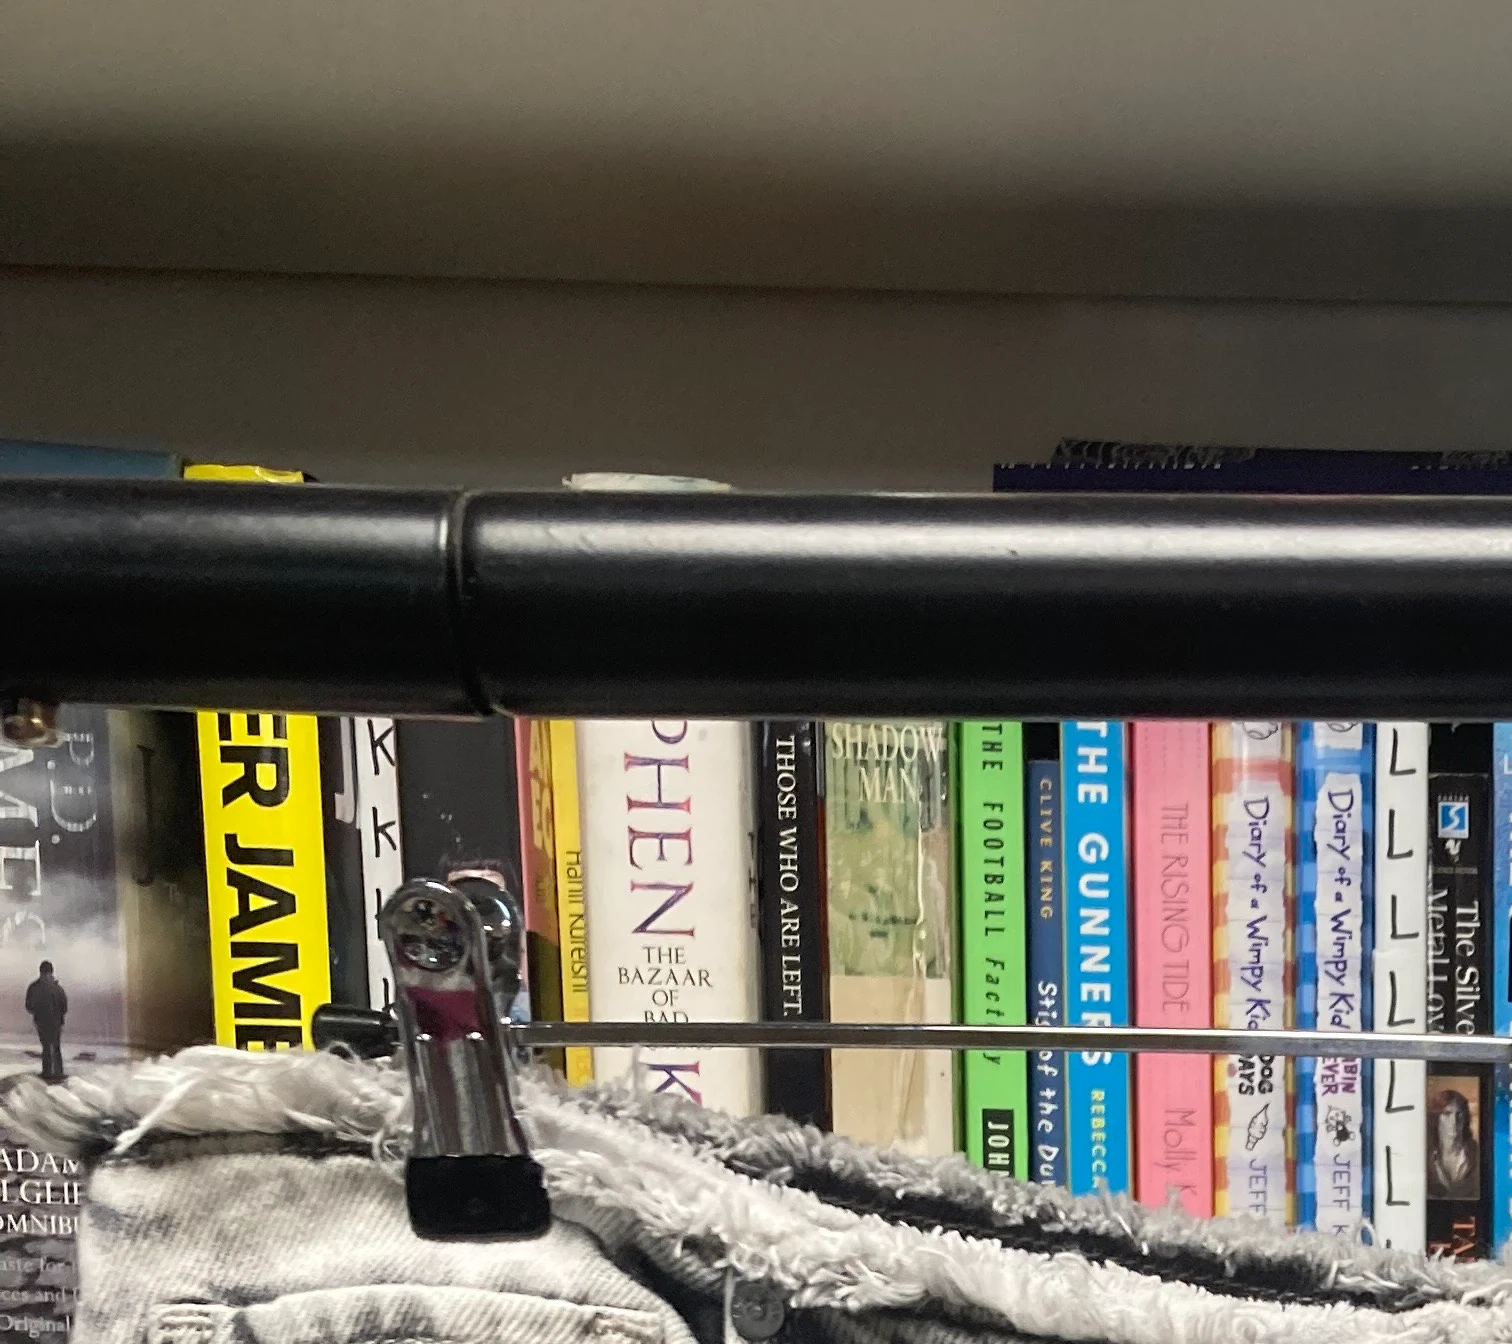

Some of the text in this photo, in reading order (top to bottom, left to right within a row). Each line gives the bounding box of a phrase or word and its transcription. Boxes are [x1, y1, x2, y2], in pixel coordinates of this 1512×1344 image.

[831, 722, 944, 764] SHADOW
[1076, 722, 1109, 805] THE
[858, 767, 920, 804] MAN
[1039, 778, 1055, 920] CLIVE KING
[1242, 795, 1271, 865] Diary
[775, 734, 803, 1017] THOSE WHO ARE LEFT.
[982, 723, 1006, 1066] THE FOOTBALL Facty
[1251, 872, 1267, 895] of
[1160, 802, 1191, 1014] THE RISING TIDE
[1248, 898, 1260, 911] a
[1322, 787, 1356, 1030] Diary of a Wimpy Kid
[617, 966, 713, 988] BAZAAR
[642, 946, 687, 965] THE
[1239, 913, 1270, 994] Wimpy
[1455, 900, 1481, 1037] The Silve
[643, 1009, 690, 1023] BAD
[652, 988, 680, 1008] OF
[1238, 1055, 1255, 1097] AYS
[1037, 1087, 1059, 1134] the
[1153, 1108, 1198, 1174] Molly
[1248, 1158, 1268, 1217] JEFF
[1331, 1153, 1352, 1213] JEFF
[0, 1213, 78, 1235] MNIB
[1451, 1215, 1476, 1264] TA
